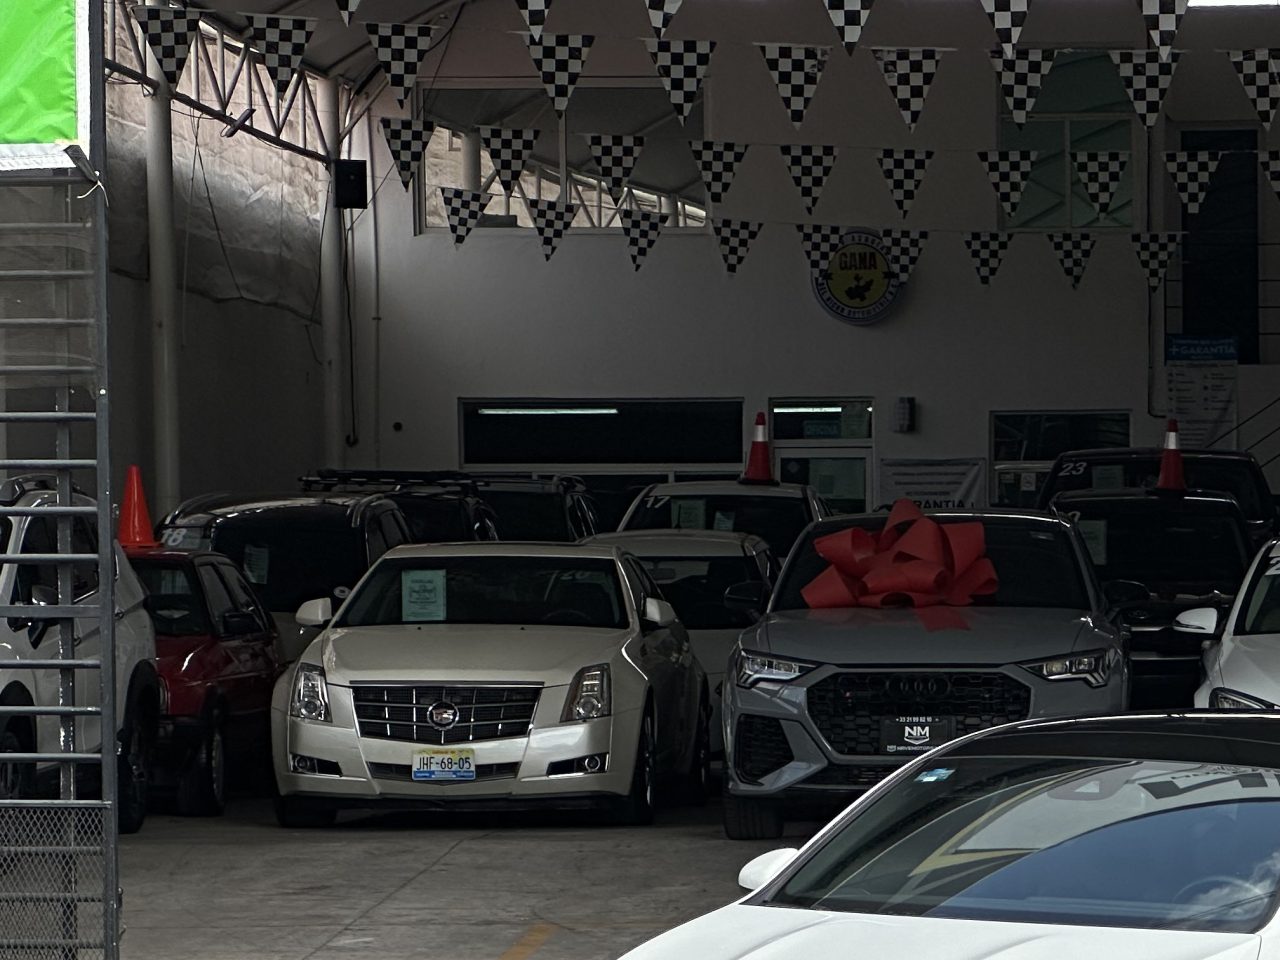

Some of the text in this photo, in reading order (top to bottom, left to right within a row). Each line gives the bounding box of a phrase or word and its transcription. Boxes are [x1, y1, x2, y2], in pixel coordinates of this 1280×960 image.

[839, 251, 877, 271] GANA
[1057, 461, 1088, 477] 23
[643, 495, 671, 509] 17
[160, 527, 188, 546] 18
[904, 725, 930, 738] NM
[416, 756, 472, 771] JHF-68-05
